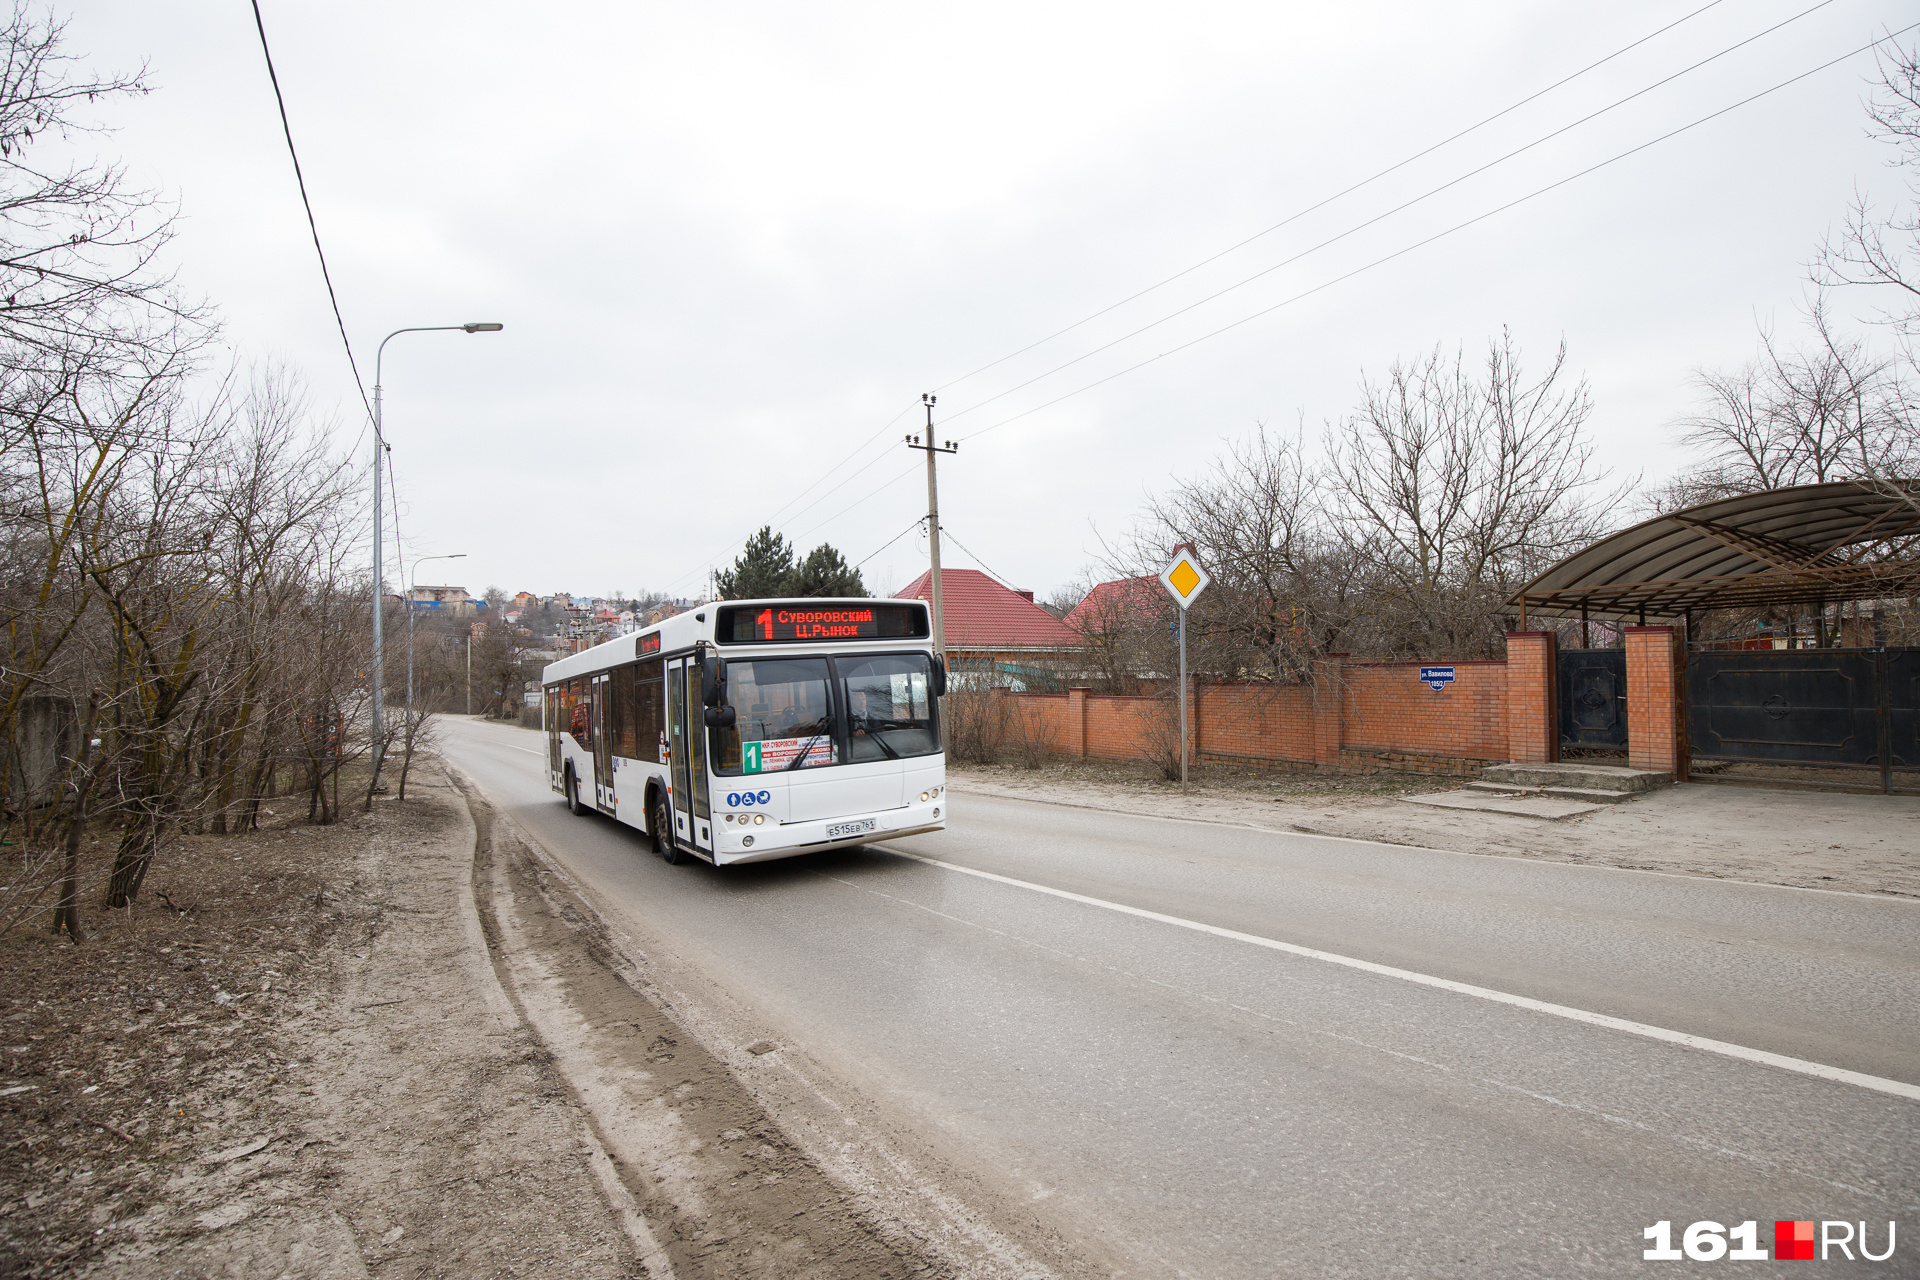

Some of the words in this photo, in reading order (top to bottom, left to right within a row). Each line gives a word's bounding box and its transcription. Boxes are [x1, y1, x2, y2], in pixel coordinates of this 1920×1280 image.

[757, 608, 773, 639] 1
[771, 739, 798, 749] СУВОРОВСКИЙ
[747, 746, 756, 769] 1
[829, 825, 861, 836] Е515ЕВ
